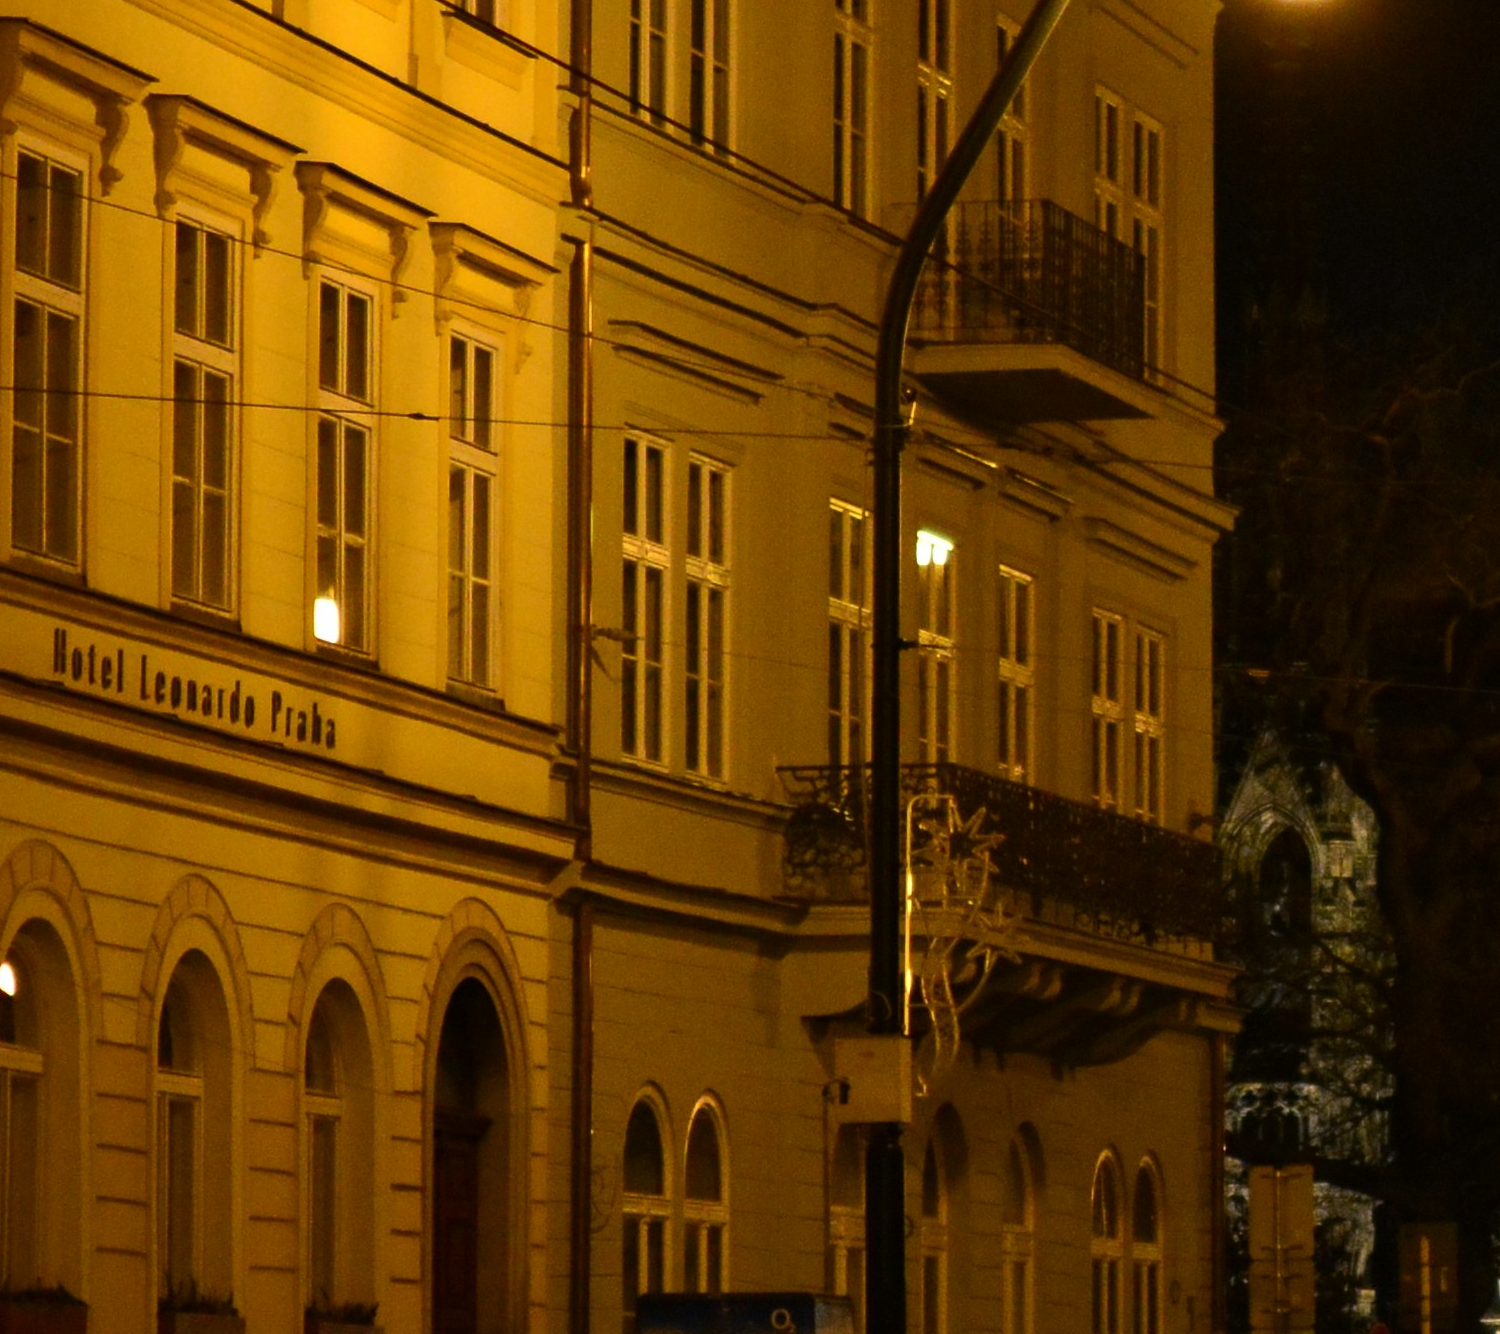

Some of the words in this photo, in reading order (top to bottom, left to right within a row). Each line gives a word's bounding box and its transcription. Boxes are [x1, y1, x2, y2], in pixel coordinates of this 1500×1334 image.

[53, 627, 125, 694] Hotel
[140, 653, 256, 729] Leonardo
[271, 689, 337, 750] Praha
